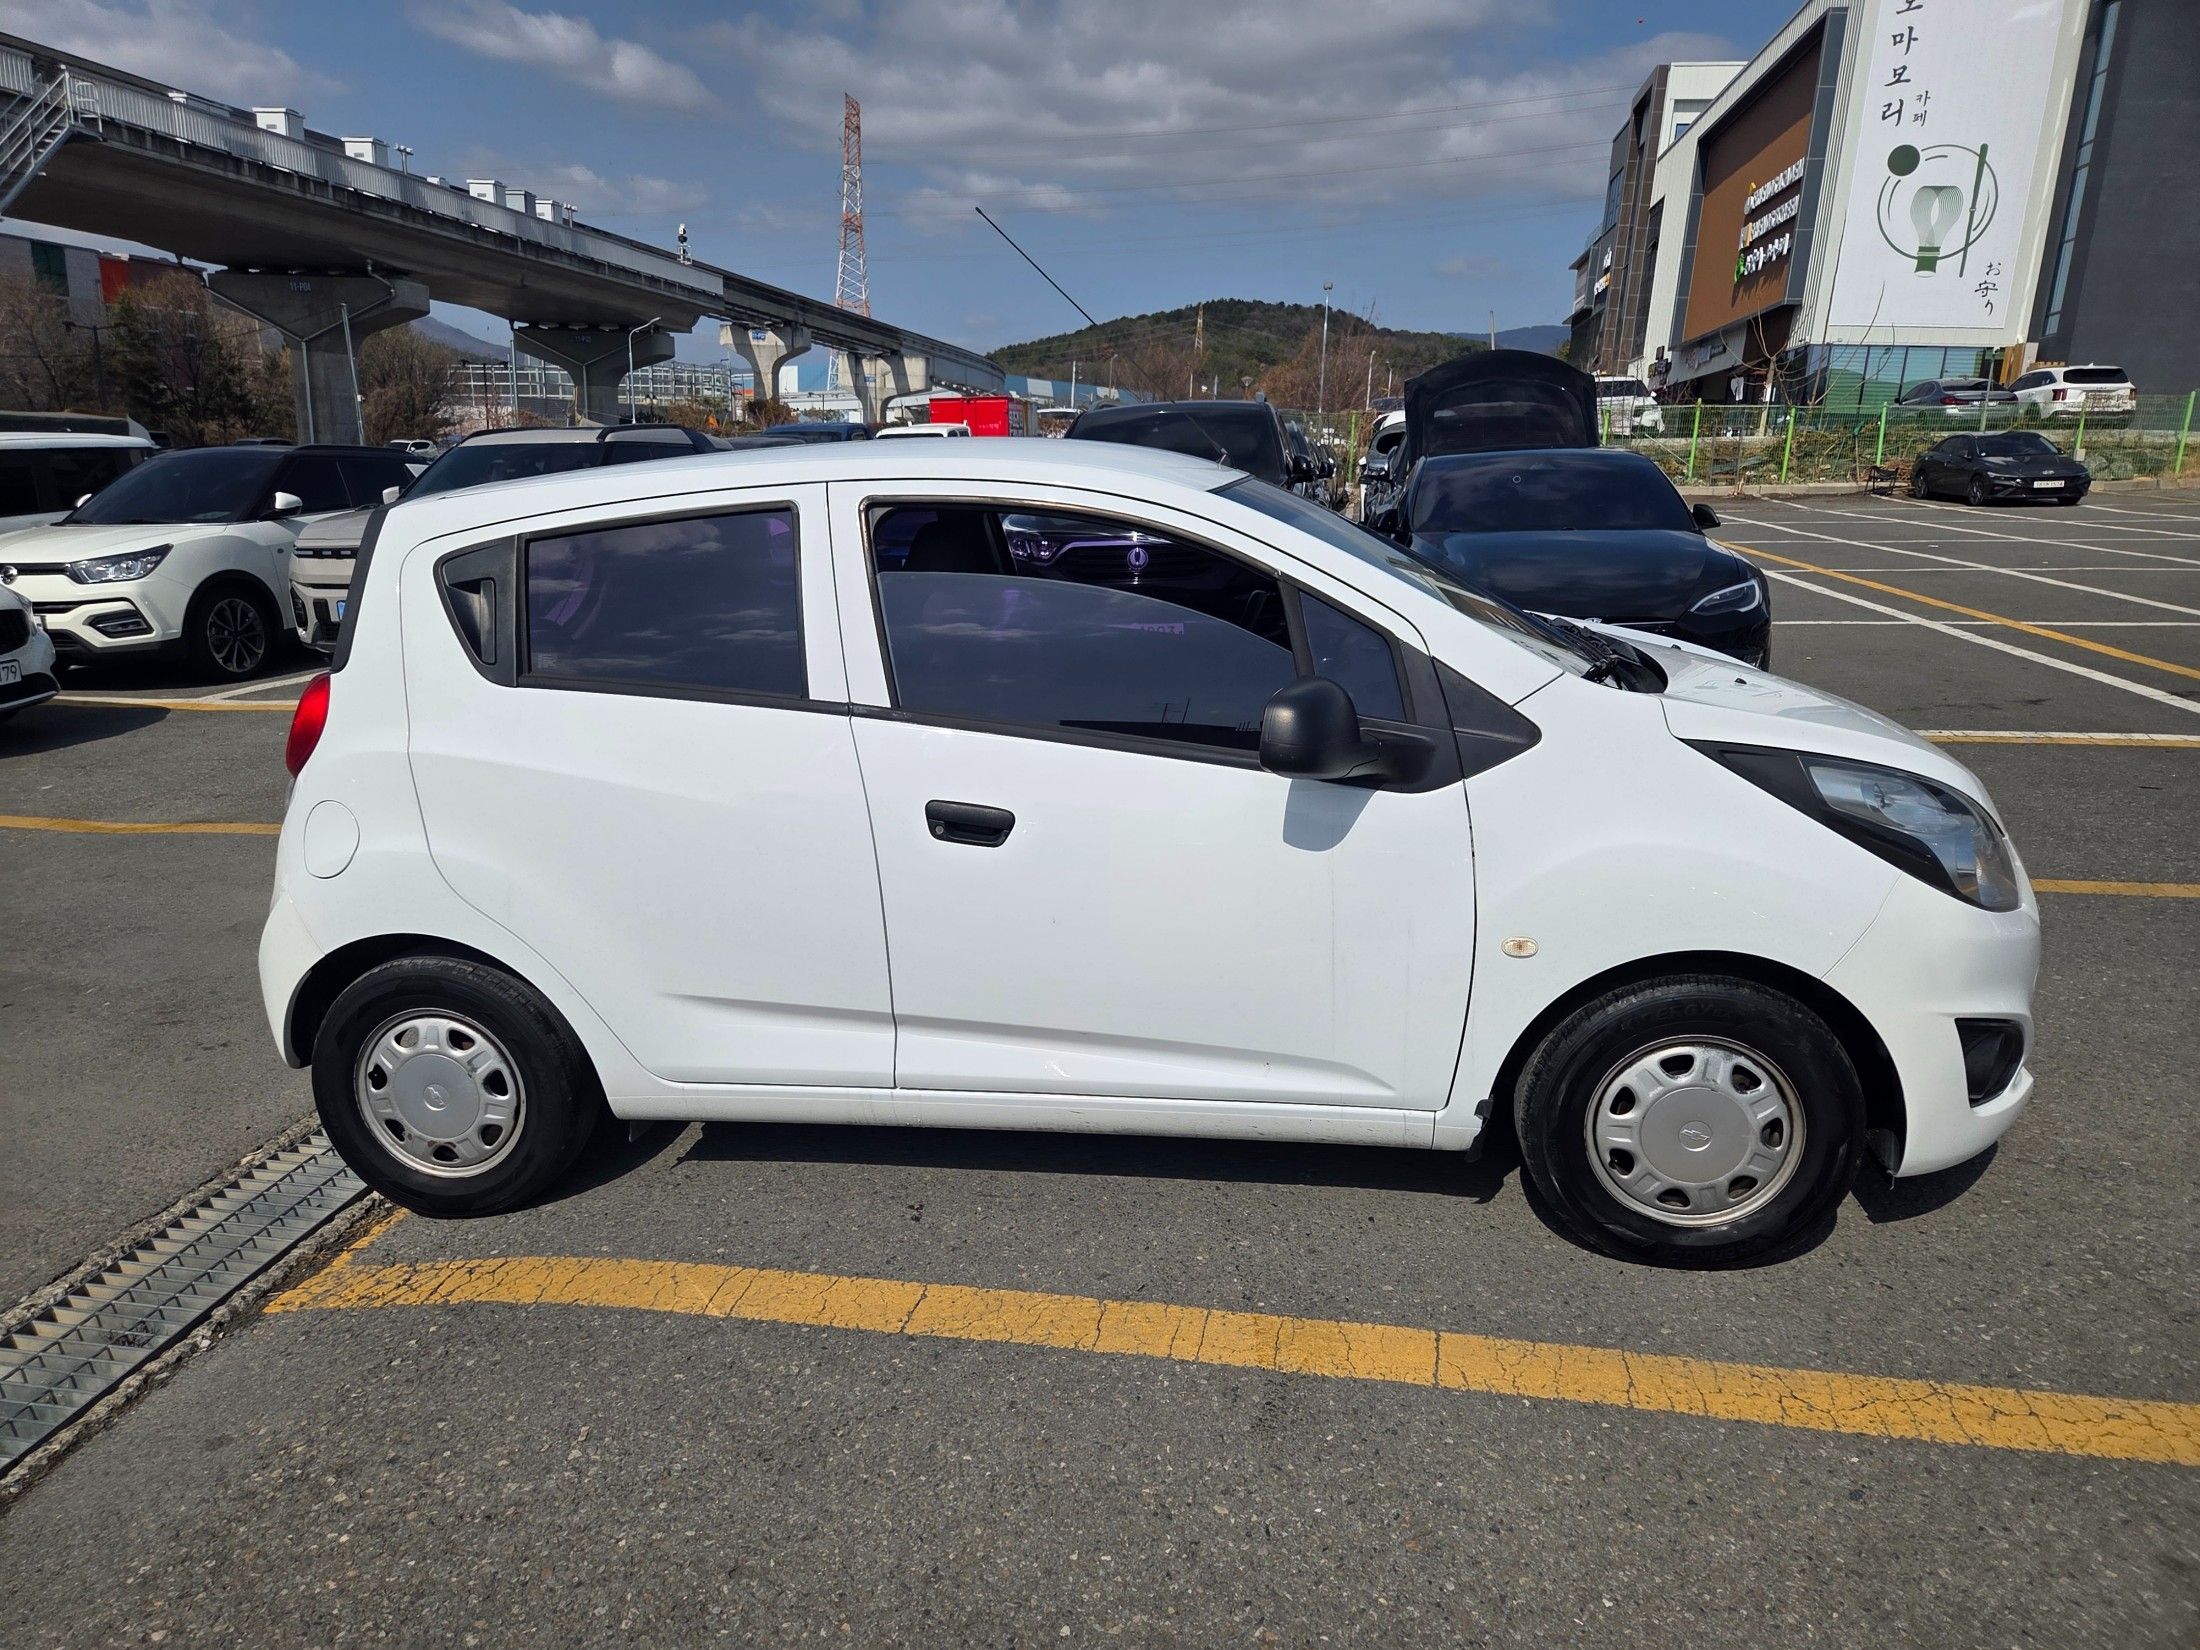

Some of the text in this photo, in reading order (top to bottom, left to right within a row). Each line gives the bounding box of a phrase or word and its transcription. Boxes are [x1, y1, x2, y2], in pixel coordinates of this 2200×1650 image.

[1912, 90, 1931, 127] 카페
[1974, 261, 2001, 316] お守り
[0, 664, 17, 683] 79
